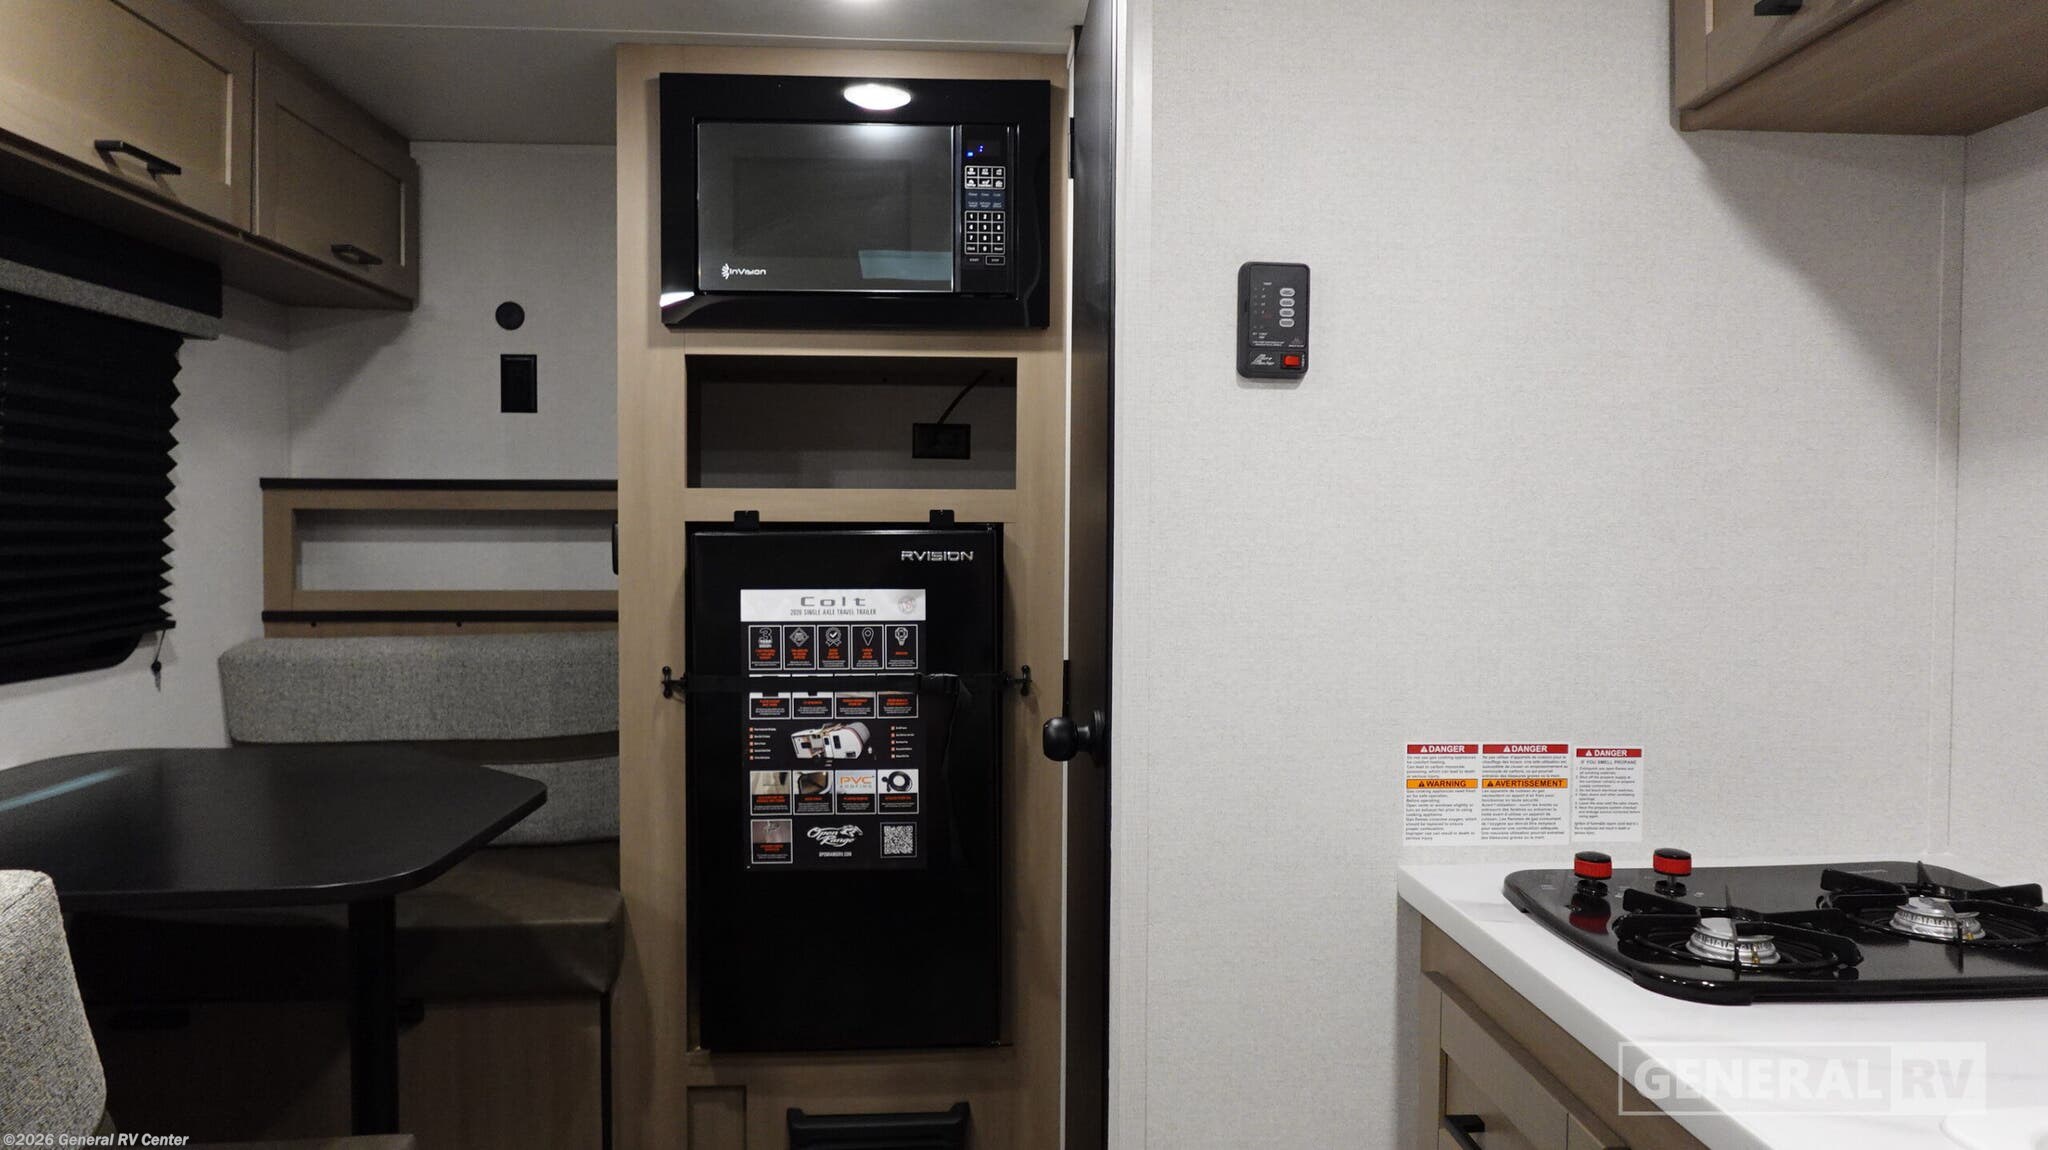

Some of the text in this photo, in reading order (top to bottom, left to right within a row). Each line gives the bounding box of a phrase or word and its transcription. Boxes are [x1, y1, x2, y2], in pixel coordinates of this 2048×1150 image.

[901, 551, 974, 561] RVISION
[800, 596, 867, 606] Colt
[840, 776, 872, 785] PVC
[807, 827, 839, 841] Open
[820, 836, 855, 847] Range
